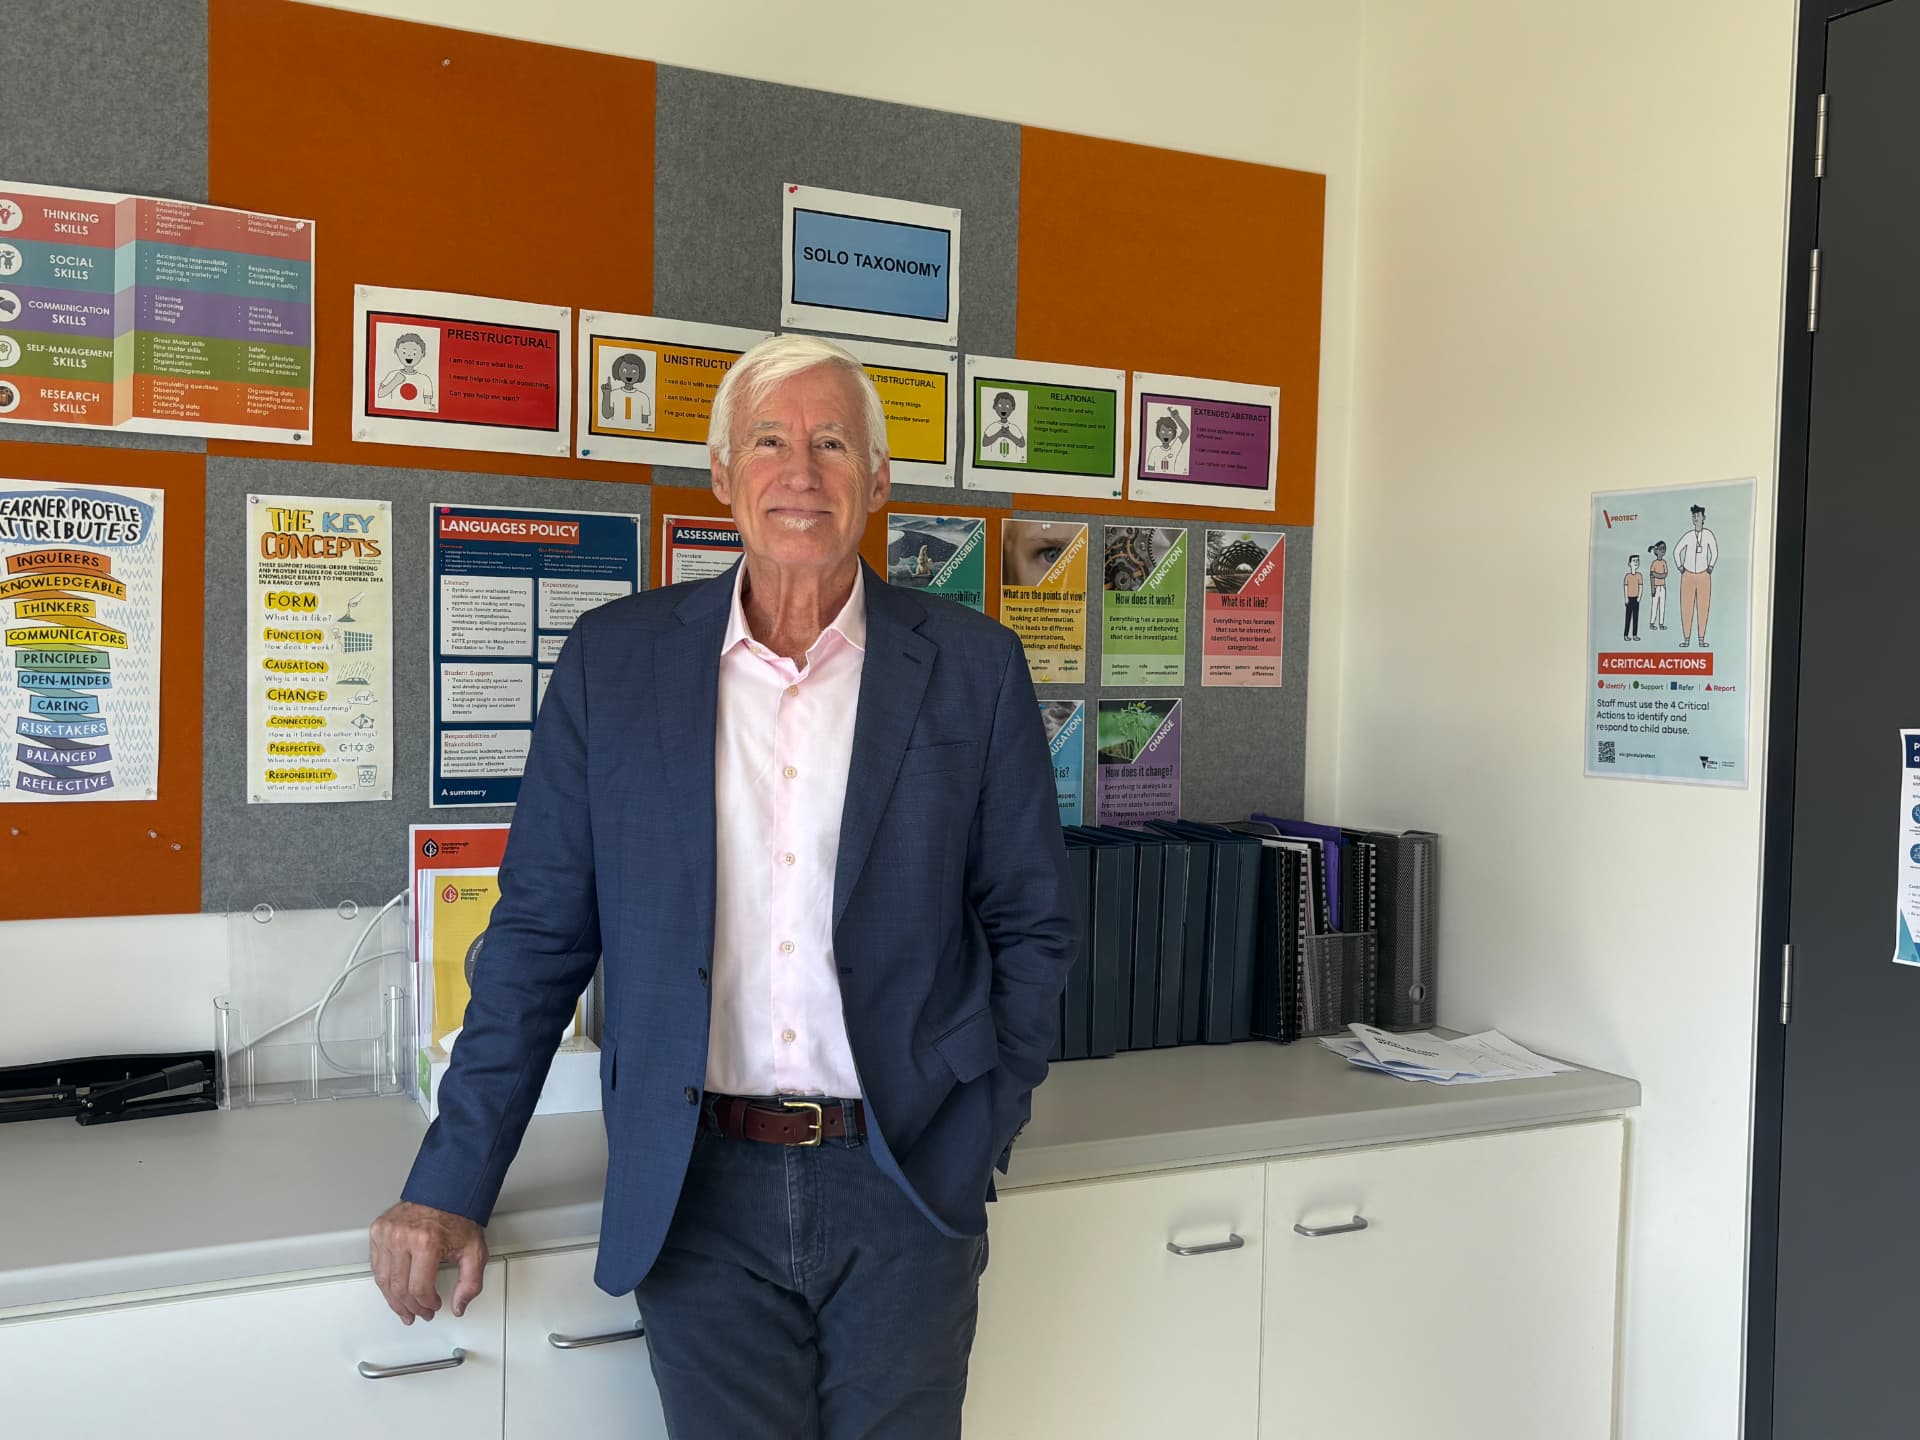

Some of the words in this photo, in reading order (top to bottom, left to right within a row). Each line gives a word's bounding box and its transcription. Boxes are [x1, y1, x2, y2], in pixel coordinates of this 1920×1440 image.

[43, 208, 99, 224] THINKING
[54, 222, 89, 235] SKILLS
[49, 254, 94, 268] SOCIAL
[803, 245, 849, 265] SOLO
[853, 252, 942, 278] TAXONOMY
[54, 267, 89, 280] SKILLS
[28, 300, 110, 315] COMMUNICATION
[52, 314, 87, 326] SKILLS
[447, 328, 552, 349] PRESTRUCTURAL
[26, 343, 113, 358] SELF-MANAGEMENT
[53, 357, 87, 369] SKILLS
[664, 353, 734, 370] UNISTRUCTU
[40, 388, 100, 402] RESEARCH
[1050, 392, 1097, 404] RELATIONAL
[53, 402, 87, 415] SKILLS
[1193, 408, 1230, 419] EXTENDED
[1230, 412, 1268, 422] ABSTRACT
[0, 497, 66, 518] EARNER
[71, 498, 140, 523] PROFILE
[266, 507, 314, 533] THE
[322, 511, 375, 534] KEY
[1610, 514, 1639, 522] PROTECT
[440, 519, 527, 535] LANGUAGES
[529, 523, 577, 537] POLICY
[676, 529, 740, 542] ASSESSMENT
[260, 531, 382, 560] CONCEPTS
[17, 552, 99, 568] INQUIRERS
[935, 526, 985, 588] RESPONSIBILITY
[1047, 536, 1086, 584] PERSPECTIVE
[1149, 546, 1183, 590] FUNCTION
[1253, 560, 1276, 586] FORM
[0, 577, 123, 596] KNOWLEDGEABLE
[268, 592, 316, 608] FORM
[1003, 588, 1019, 599] What
[1020, 591, 1030, 599] are
[1032, 589, 1041, 600] the
[1042, 590, 1062, 602] points
[1063, 591, 1069, 600] of
[1070, 591, 1086, 602] view?
[1116, 593, 1130, 605] How
[1131, 593, 1147, 605] does
[1149, 594, 1154, 605] it
[1155, 594, 1175, 605] work?
[1221, 595, 1238, 607] What
[1239, 596, 1246, 608] is
[1246, 596, 1252, 608] it
[1253, 596, 1269, 608] like?
[22, 601, 90, 615] THINKERS
[265, 613, 289, 621] What
[311, 613, 332, 621] like?
[1010, 615, 1031, 623] looking
[1109, 615, 1140, 623] Everything
[266, 629, 322, 641] FUNCTION
[1153, 625, 1179, 633] behaving
[9, 629, 125, 645] COMMUNICATORS
[23, 653, 98, 664] PRINCIPLED
[265, 659, 324, 670] CAUSATION
[1602, 658, 1609, 668] 4
[1610, 658, 1657, 669] CRITICAL
[1658, 658, 1707, 670] ACTIONS
[21, 674, 110, 686] OPEN-MINDED
[1640, 683, 1664, 691] Support
[1713, 685, 1736, 693] Report
[267, 689, 326, 701] CHANGE
[37, 700, 89, 711] CARING
[1597, 698, 1616, 708] Staff
[1617, 699, 1637, 709] must
[1654, 700, 1669, 709] the
[1670, 701, 1677, 709] 4
[1677, 700, 1710, 711] Critical
[270, 717, 323, 725] CONNECTION
[1597, 710, 1626, 720] Actions
[1627, 711, 1636, 720] to
[1637, 711, 1668, 723] identify
[1670, 713, 1687, 722] and
[21, 722, 106, 735] RISK-TAKERS
[1596, 723, 1628, 733] respond
[1630, 723, 1639, 732] to
[1639, 723, 1660, 734] child
[1661, 725, 1690, 735] abuse.
[1148, 719, 1175, 752] CHANGE
[270, 743, 321, 752] PERSPECTIVE
[26, 749, 97, 763] BALANCED
[269, 770, 332, 779] RESPONSIBILITY
[1059, 766, 1070, 778] is?
[1105, 766, 1119, 777] How
[1121, 765, 1138, 777] does
[1138, 765, 1145, 777] it
[1145, 764, 1174, 779] change?
[22, 775, 108, 791] REFLECTIVE
[441, 788, 448, 796] A
[449, 789, 487, 797] summary
